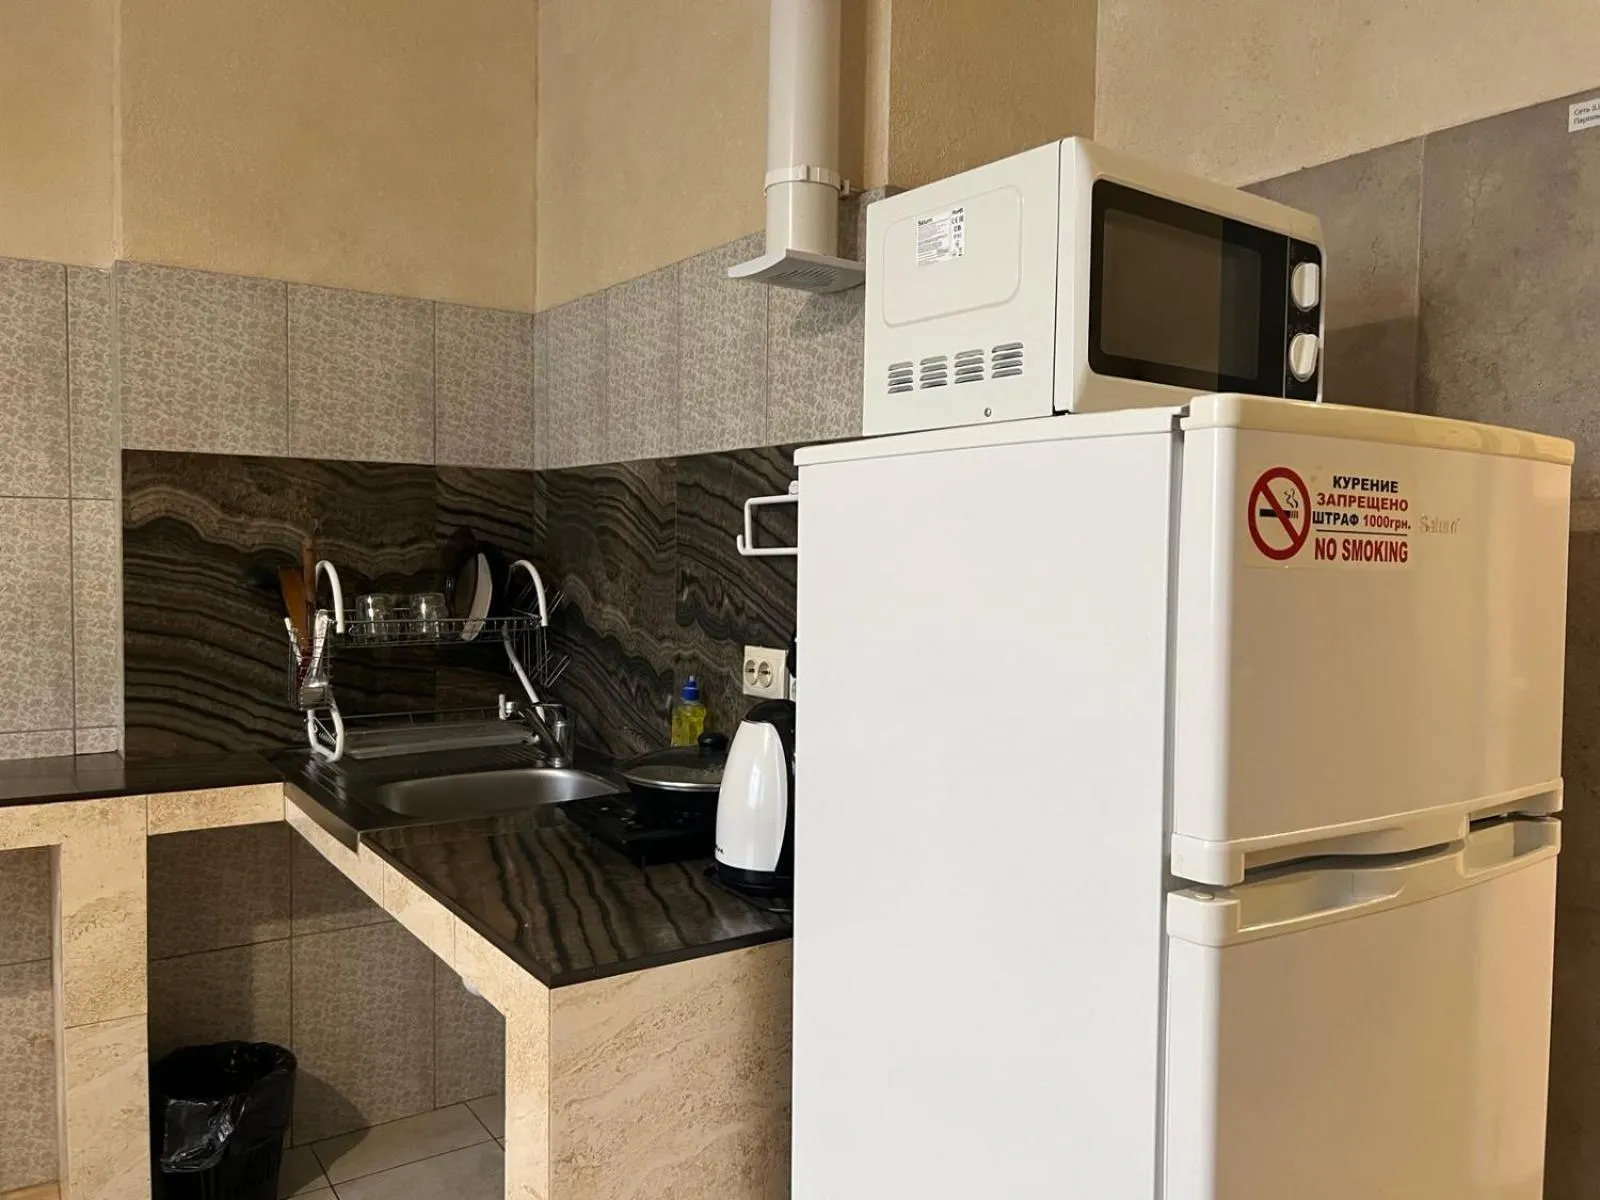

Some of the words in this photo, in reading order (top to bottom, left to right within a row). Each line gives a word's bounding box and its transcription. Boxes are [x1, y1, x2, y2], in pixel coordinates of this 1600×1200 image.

[1333, 475, 1399, 493] КУРЕНИЕ
[1317, 492, 1409, 512] ЗАПРЕЩЕНО
[1312, 510, 1359, 526] ШТРАФ
[1363, 514, 1411, 532] 1000грн.
[1314, 537, 1337, 561] NO
[1341, 538, 1408, 563] SMOKING
